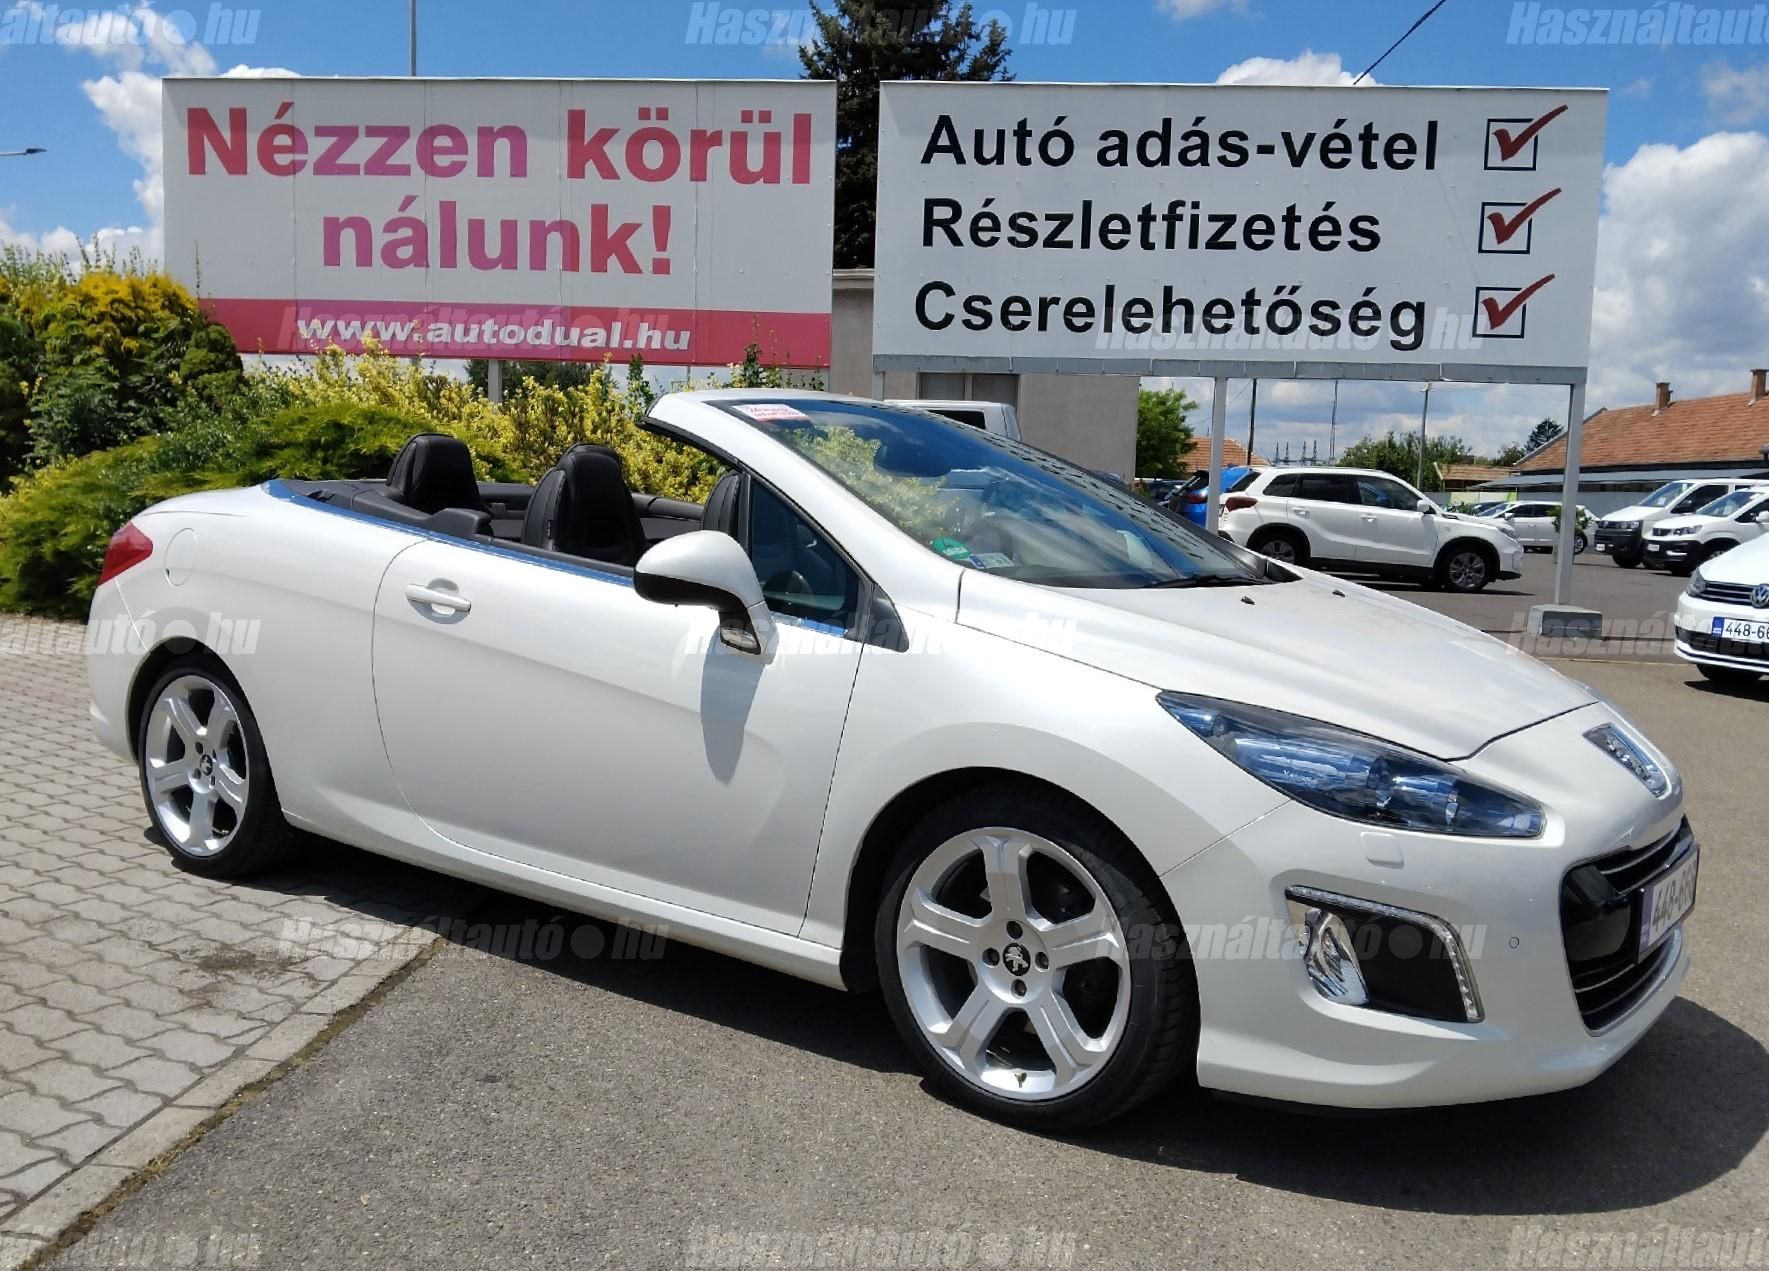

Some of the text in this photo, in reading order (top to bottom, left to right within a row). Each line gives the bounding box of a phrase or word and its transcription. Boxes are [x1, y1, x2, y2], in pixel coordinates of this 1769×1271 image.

[187, 101, 812, 185] Nézzen körül
[920, 114, 1438, 171] Autó adás-vétel
[323, 195, 671, 275] nálunk!
[922, 197, 1381, 252] Részletfizetés
[297, 318, 691, 351] www.autodual.hu
[915, 280, 1426, 351] Cserelehetőség
